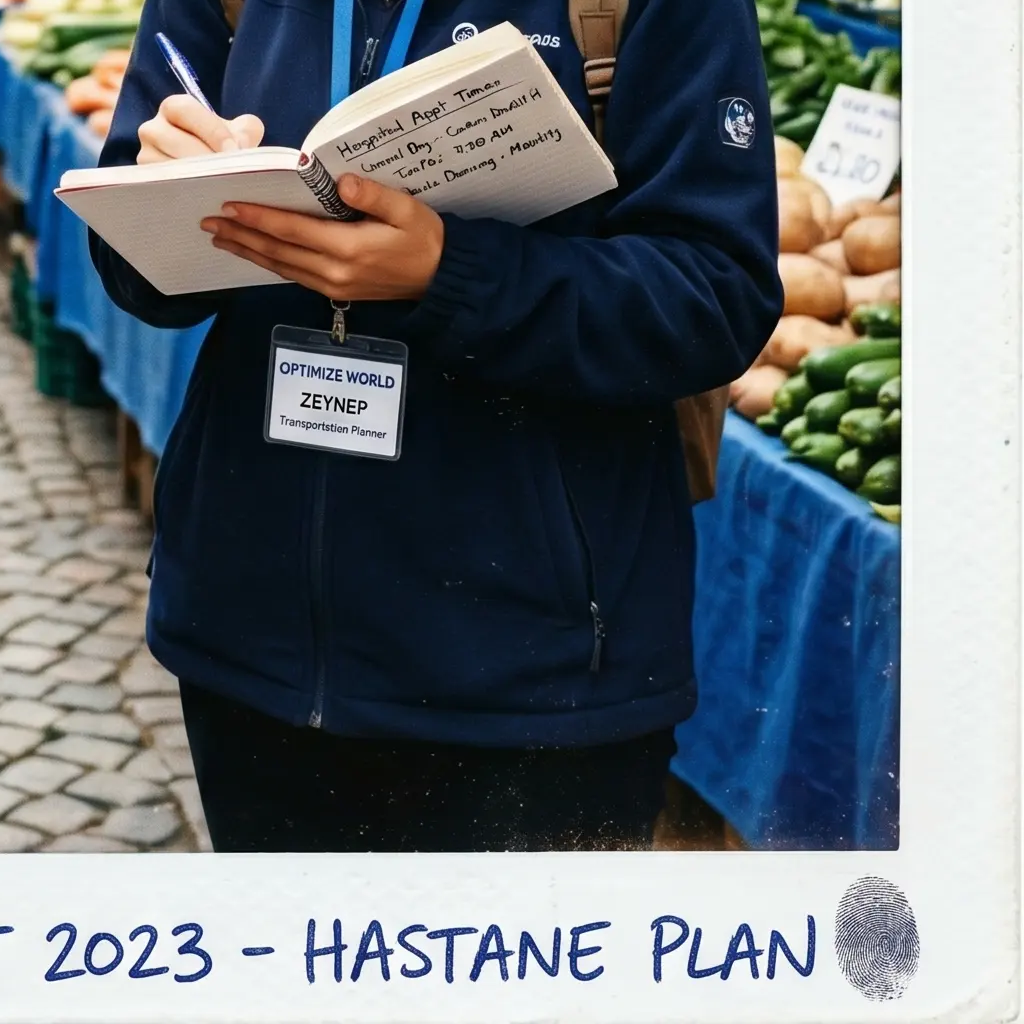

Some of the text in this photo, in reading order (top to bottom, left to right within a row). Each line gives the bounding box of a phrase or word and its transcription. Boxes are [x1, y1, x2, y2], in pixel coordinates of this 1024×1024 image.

[279, 361, 395, 389] OPTIMIZE WORLD
[299, 391, 368, 415] ZEYNEP
[350, 425, 387, 439] Planner
